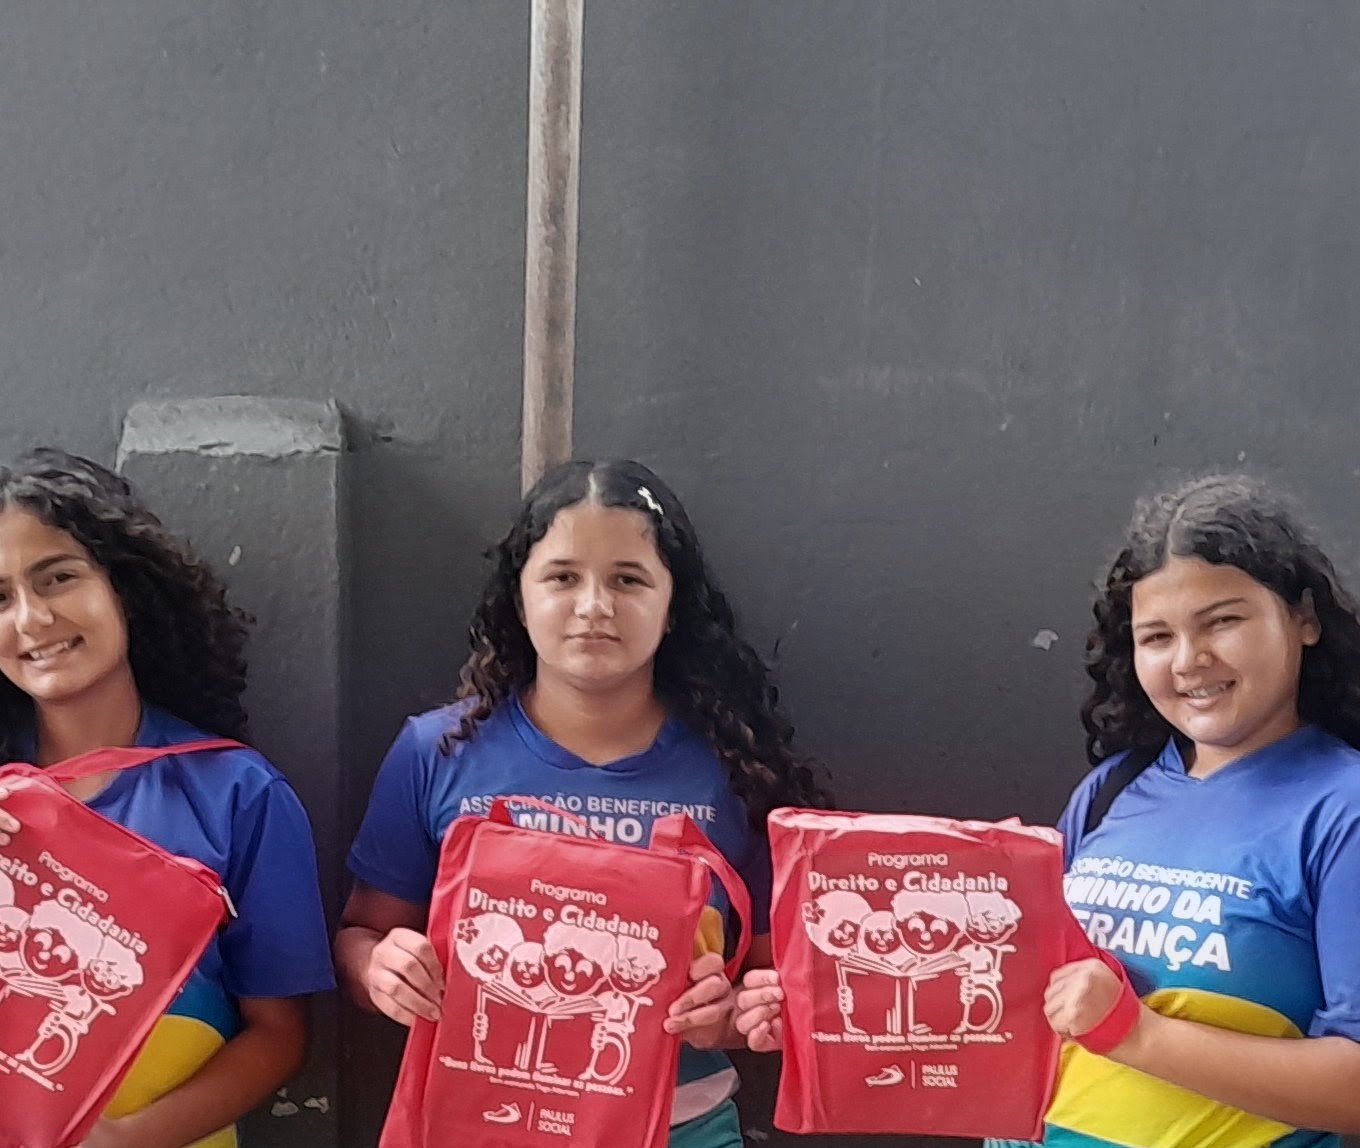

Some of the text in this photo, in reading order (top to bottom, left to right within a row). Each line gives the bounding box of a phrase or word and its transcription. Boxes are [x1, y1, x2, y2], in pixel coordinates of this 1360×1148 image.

[587, 797, 717, 823] BENEFICENTE
[518, 812, 643, 843] MINHO
[868, 852, 949, 869] Programa
[530, 878, 608, 906] Programa
[807, 870, 1009, 892] Direito e Cidadania
[40, 882, 55, 897] e
[56, 887, 149, 956] Cidadania
[468, 887, 660, 941] Direito e Cidadania
[1171, 889, 1222, 926] DA
